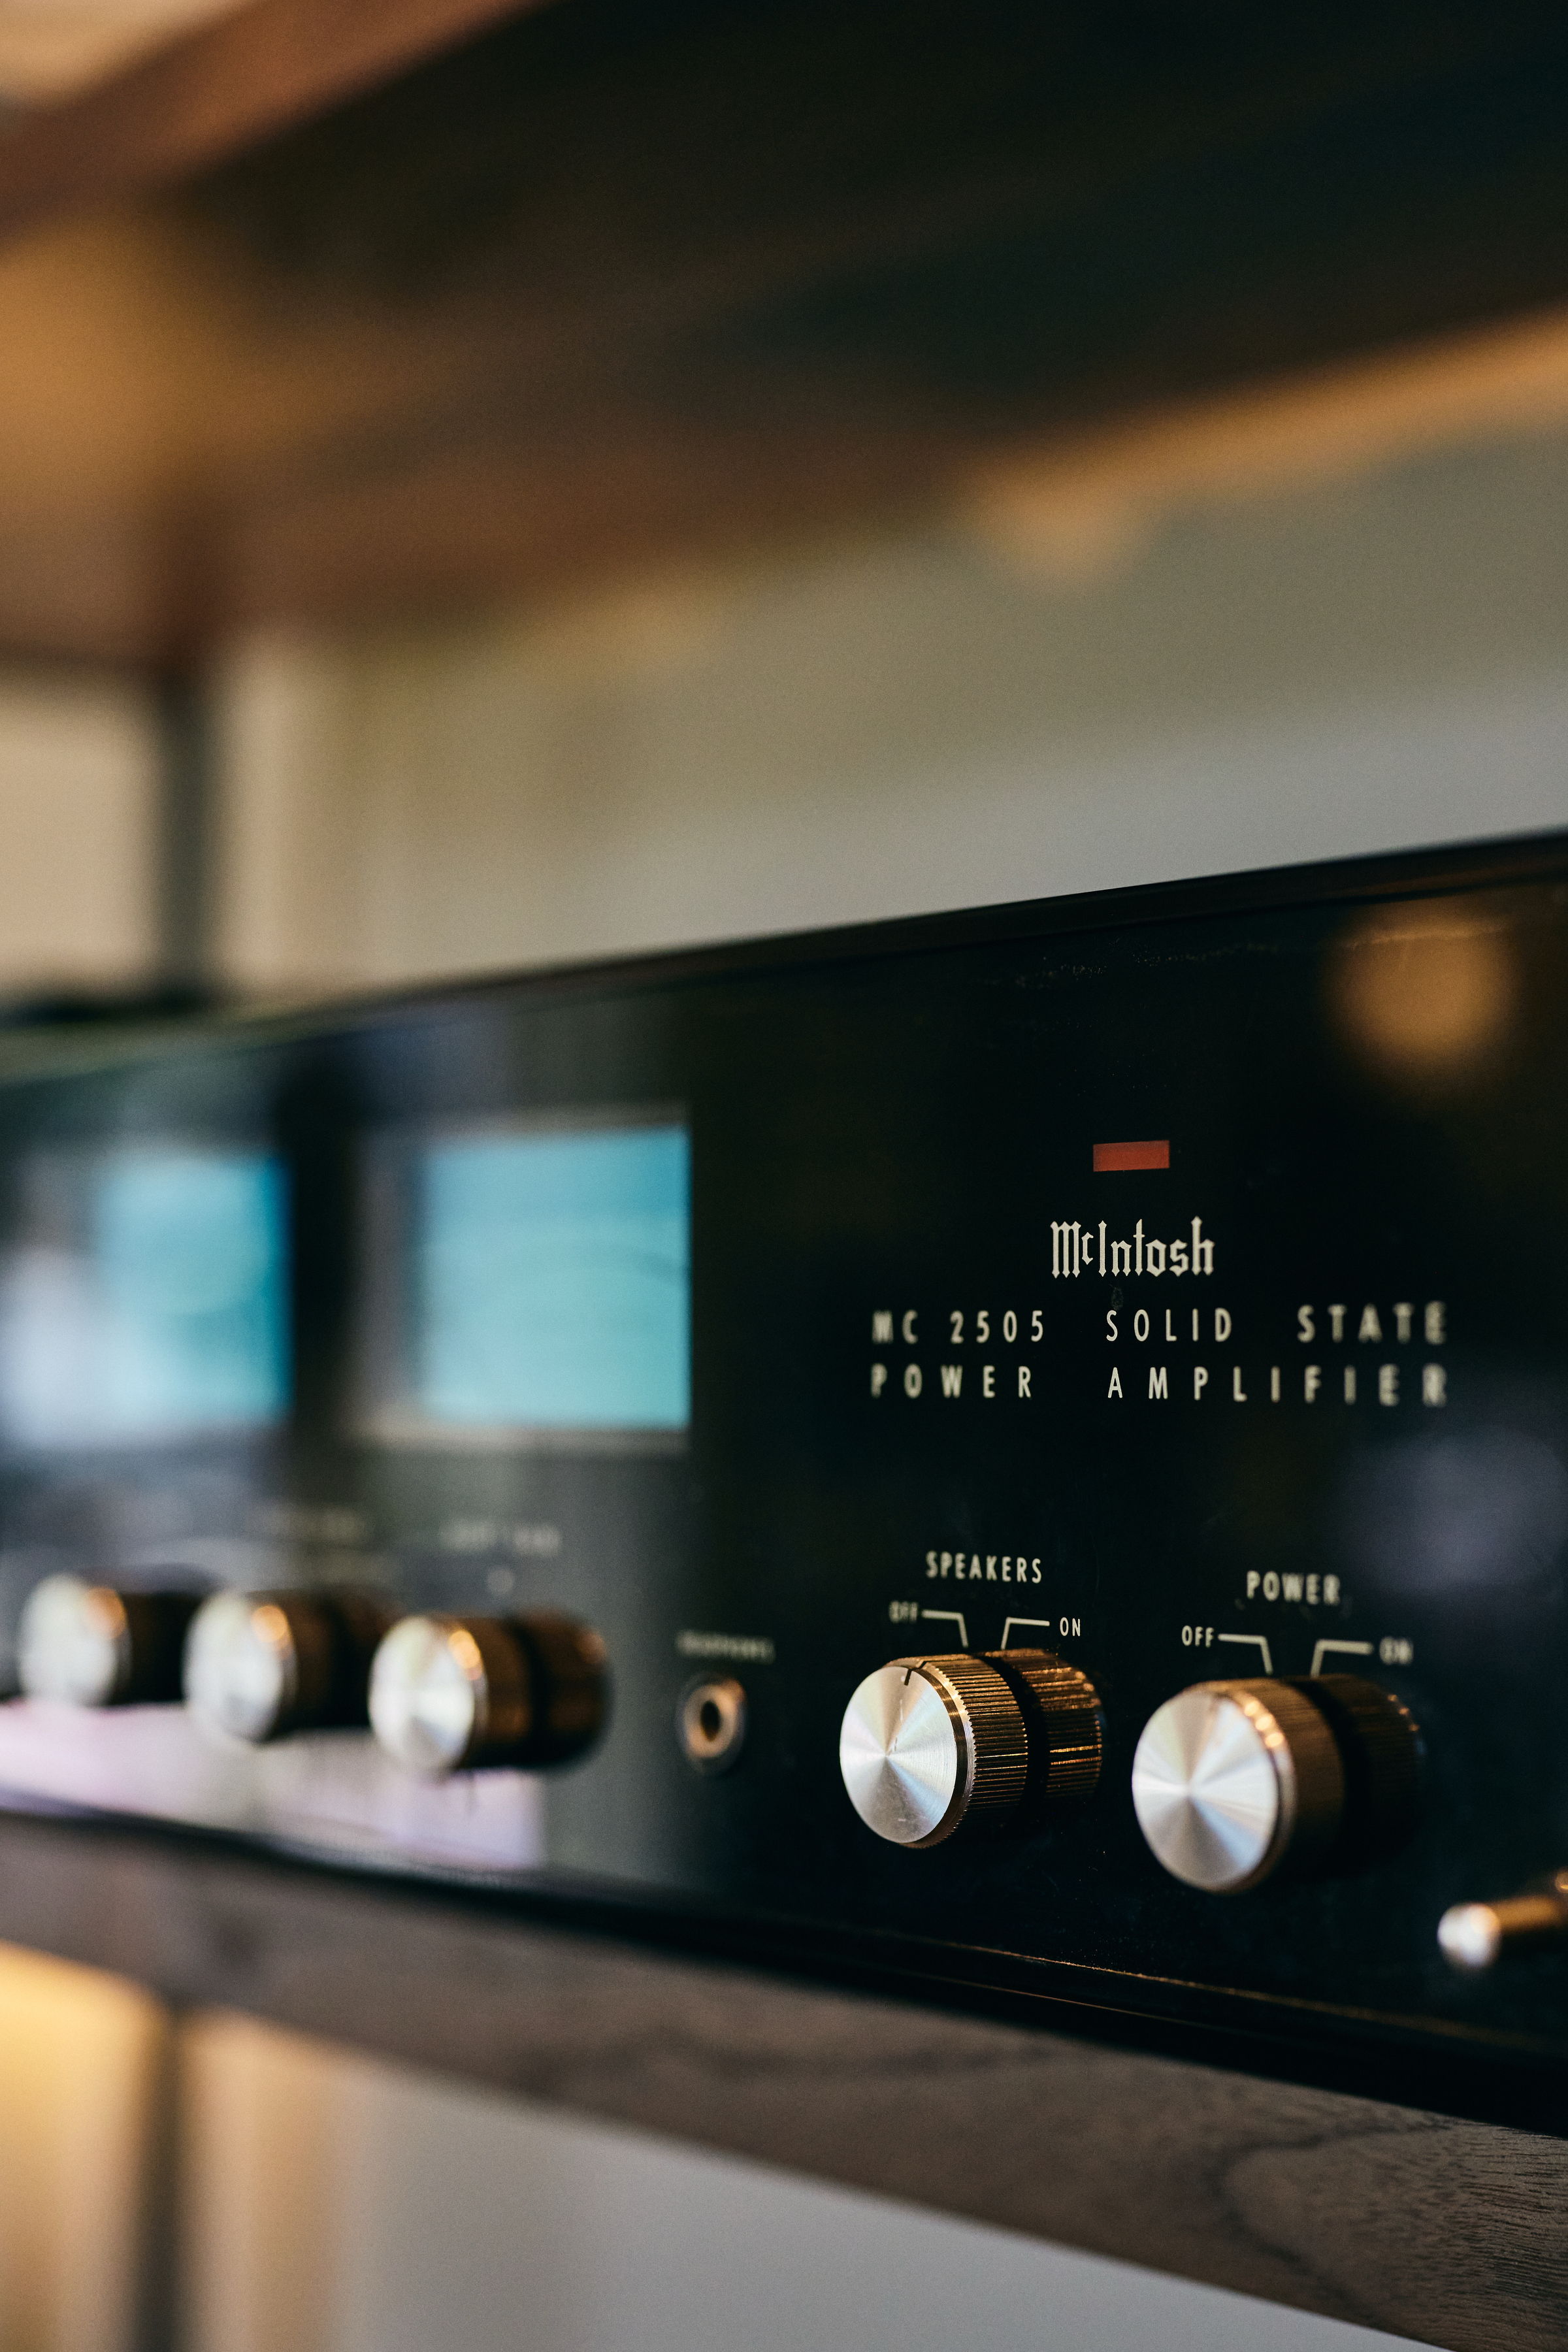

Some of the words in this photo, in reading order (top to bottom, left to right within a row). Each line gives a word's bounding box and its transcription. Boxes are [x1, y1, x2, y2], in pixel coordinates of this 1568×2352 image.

[1050, 1216, 1215, 1279] McIntosh
[872, 1310, 918, 1344] MC
[949, 1310, 1044, 1344] 2505
[1105, 1307, 1232, 1342] SOLID
[1297, 1301, 1446, 1345] STATE
[871, 1364, 1032, 1398] POWER
[1107, 1364, 1446, 1407] AMPLIFIER
[926, 1551, 1042, 1584] SPEAKERS
[1246, 1571, 1341, 1605] POWER
[1058, 1616, 1081, 1637] ON
[1181, 1625, 1215, 1648] OFF
